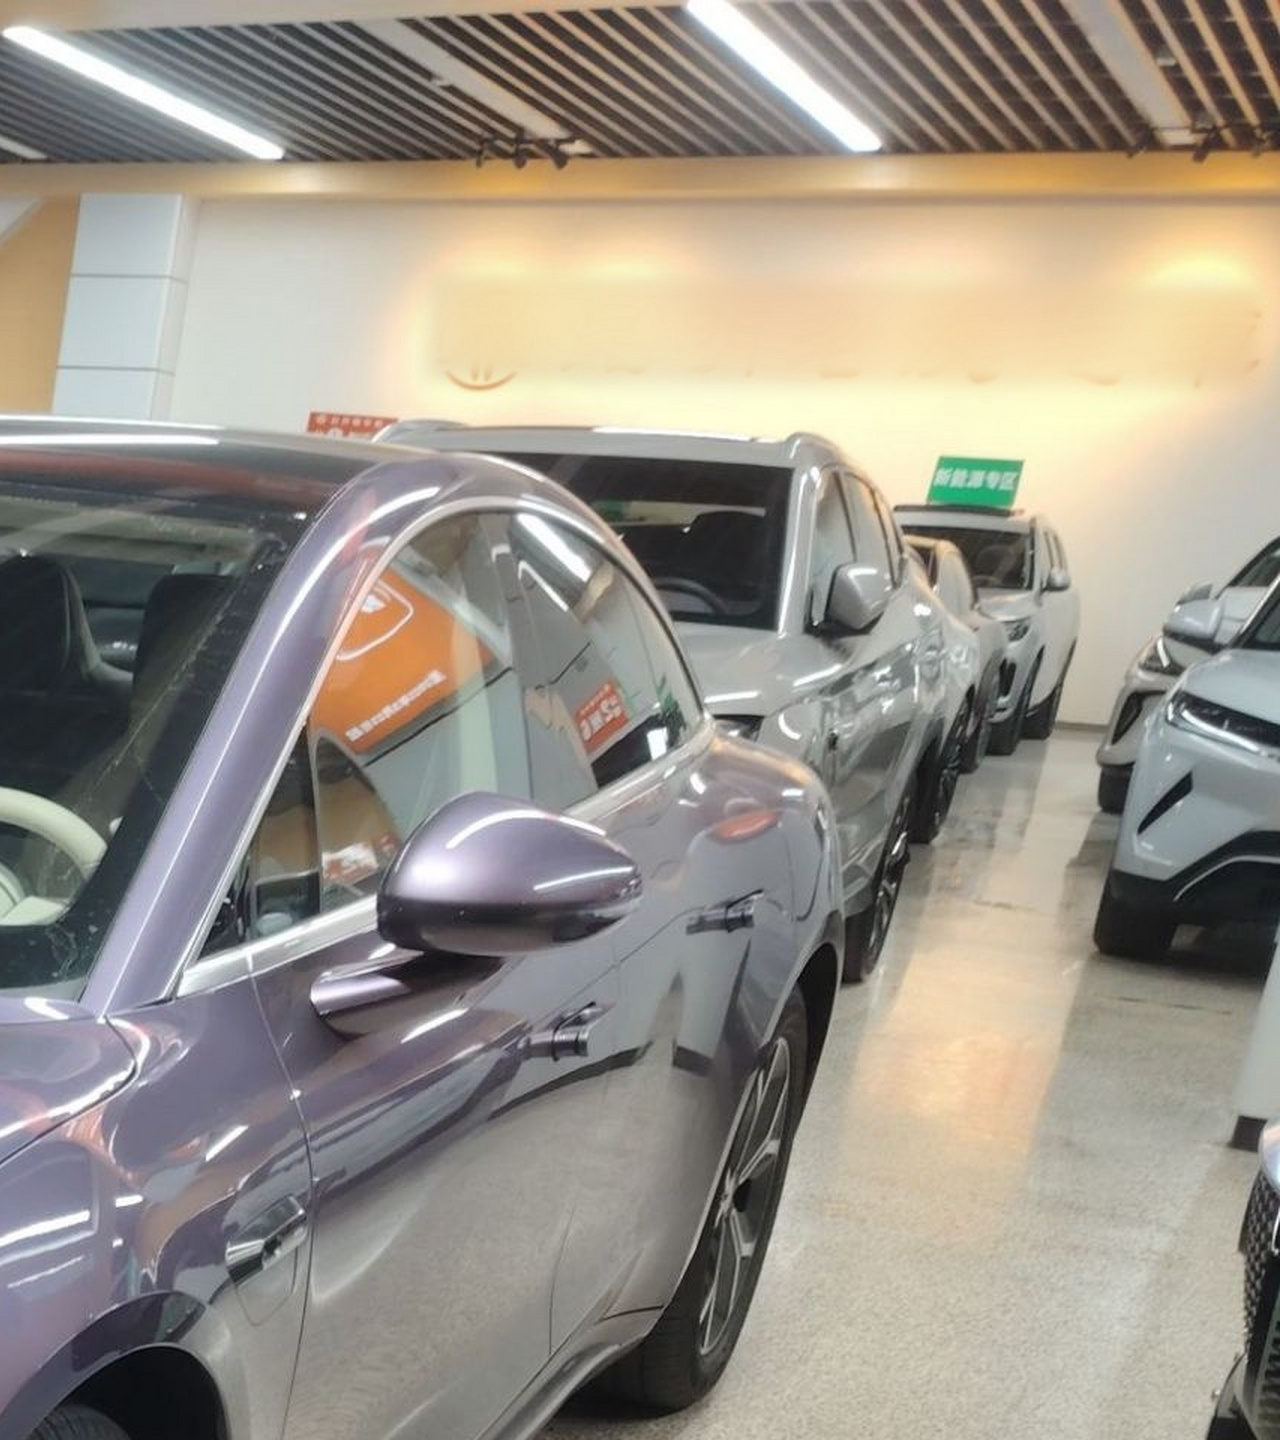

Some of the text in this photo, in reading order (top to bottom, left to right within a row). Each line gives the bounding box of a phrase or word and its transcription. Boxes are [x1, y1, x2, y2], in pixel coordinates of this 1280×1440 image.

[933, 467, 1019, 491] 新能源专区
